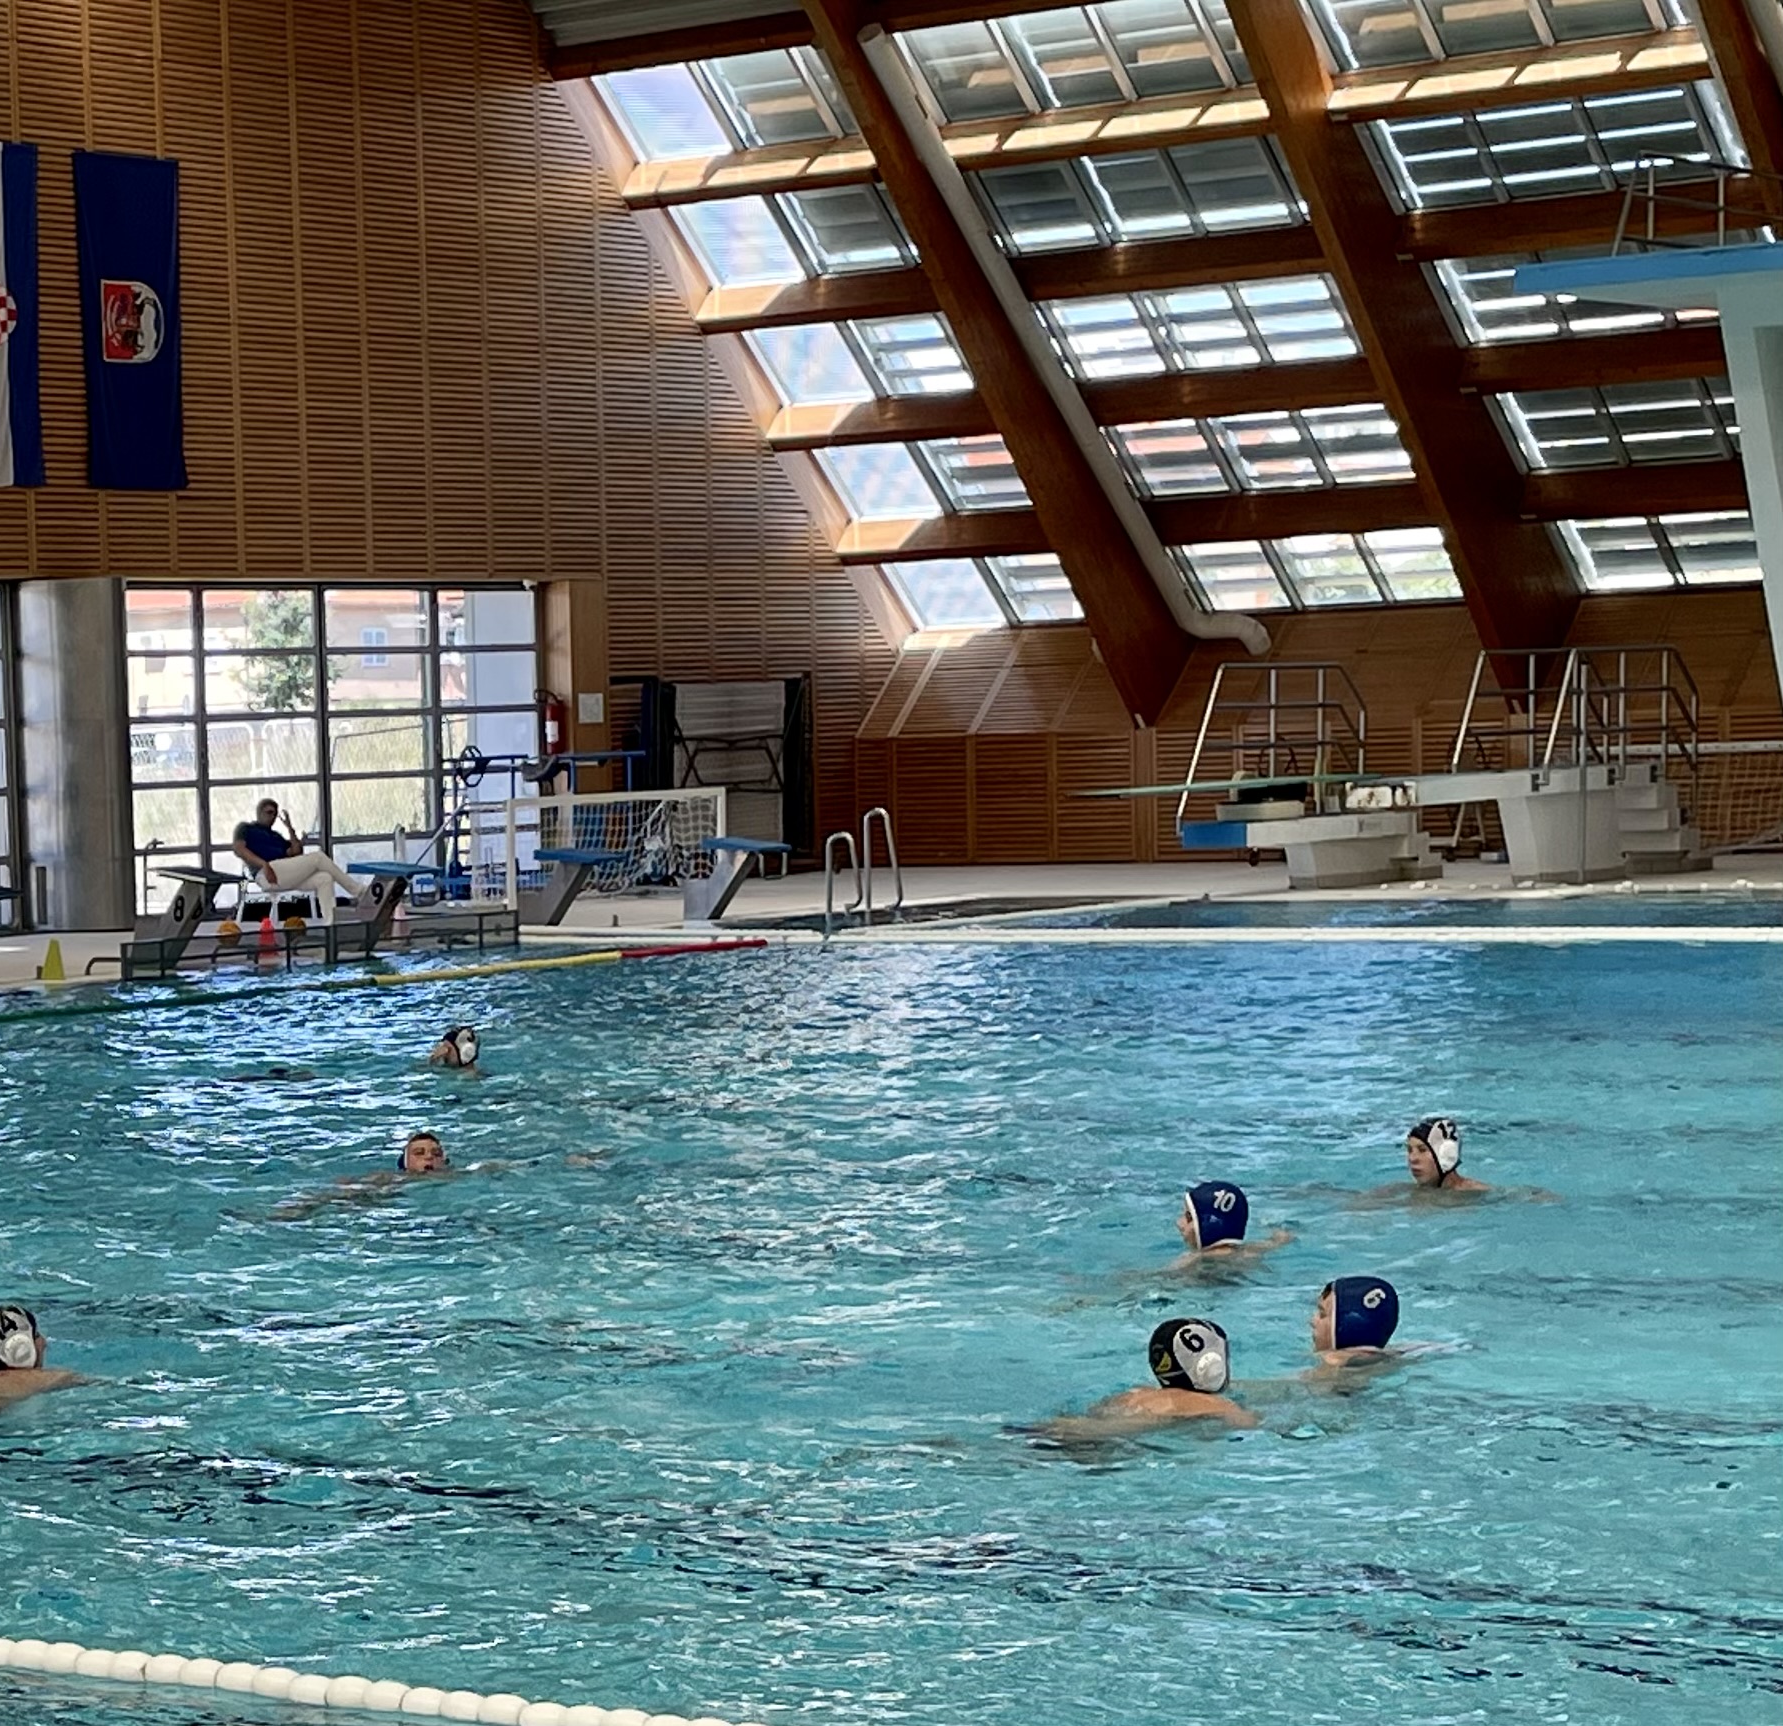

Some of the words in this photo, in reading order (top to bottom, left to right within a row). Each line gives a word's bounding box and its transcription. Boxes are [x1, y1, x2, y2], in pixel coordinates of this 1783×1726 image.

[371, 882, 384, 905] 9
[174, 895, 185, 922] 8
[1213, 1189, 1237, 1212] 10
[1363, 1288, 1386, 1309] 6
[1179, 1328, 1205, 1353] 6
